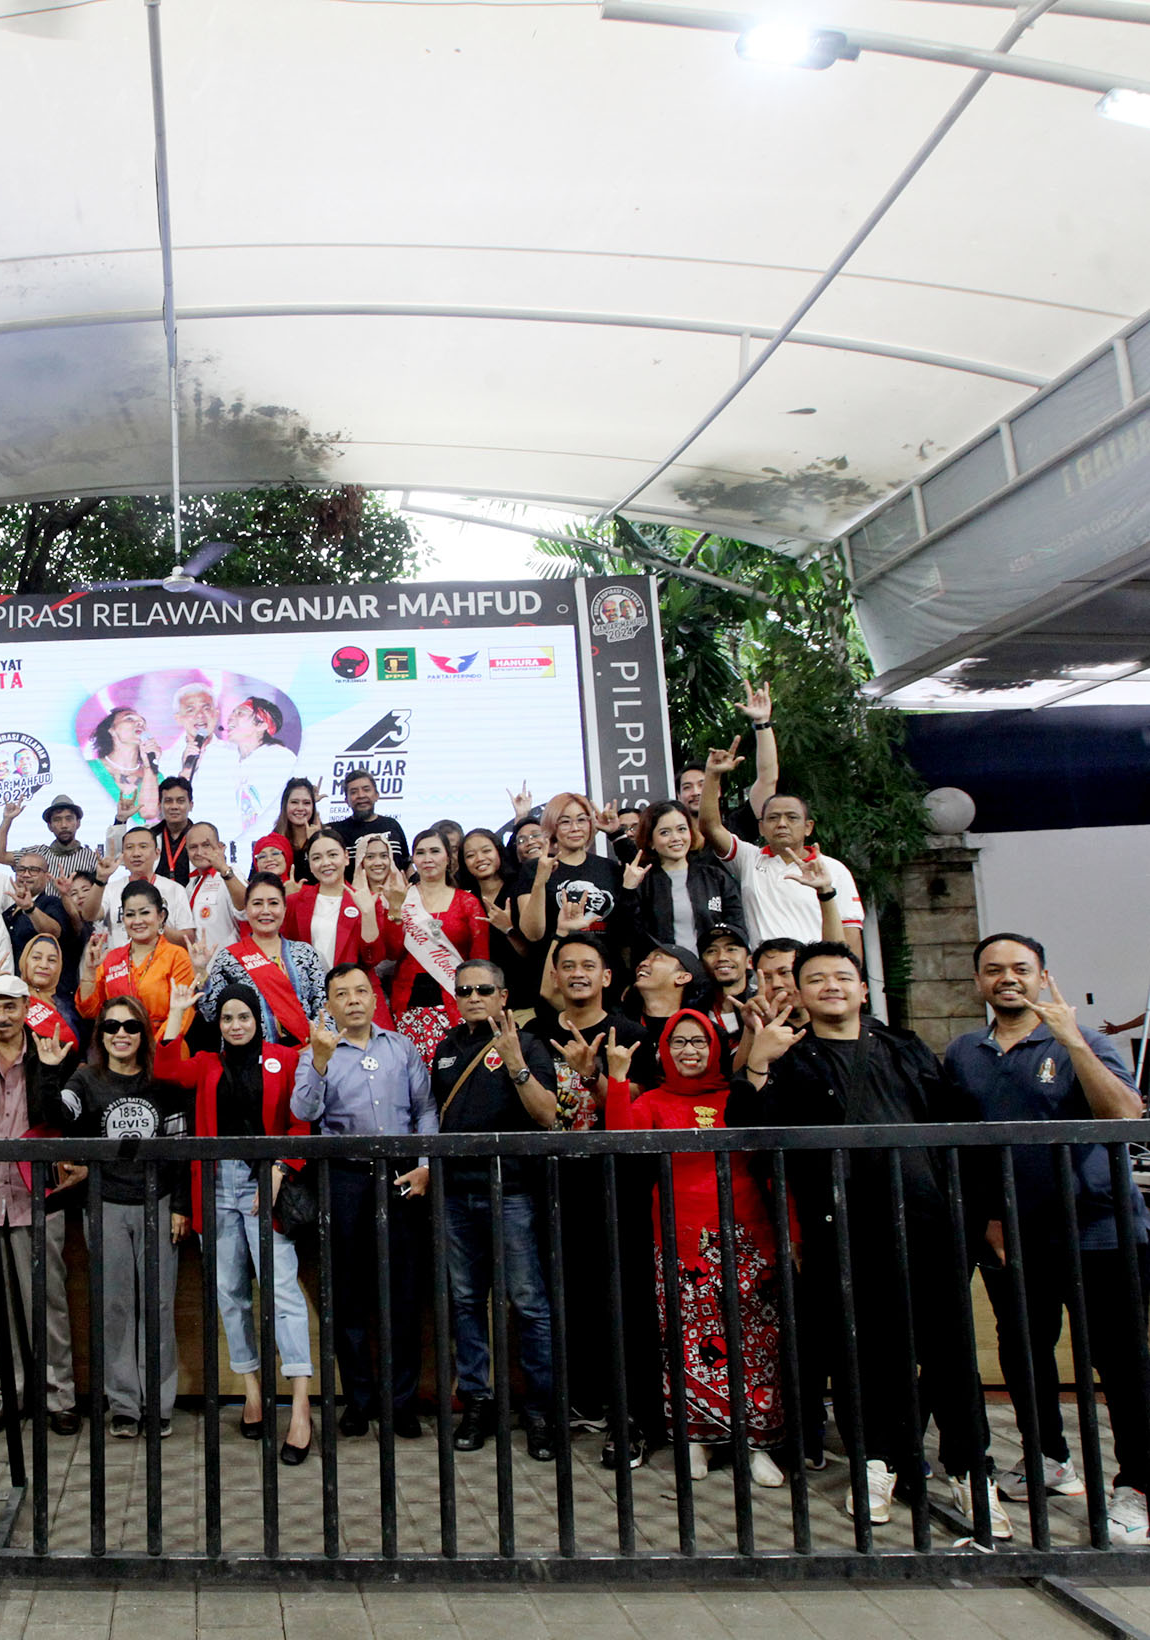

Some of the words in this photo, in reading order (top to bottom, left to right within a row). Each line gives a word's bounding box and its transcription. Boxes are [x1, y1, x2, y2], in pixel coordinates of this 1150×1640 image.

[94, 598, 244, 627] RELAWAN
[610, 627, 633, 639] 2024
[495, 659, 540, 667] HANURA
[19, 734, 47, 759] RELAWAN
[333, 760, 407, 777] GANJAR
[332, 778, 403, 795] MUD
[119, 1106, 143, 1118] 1853
